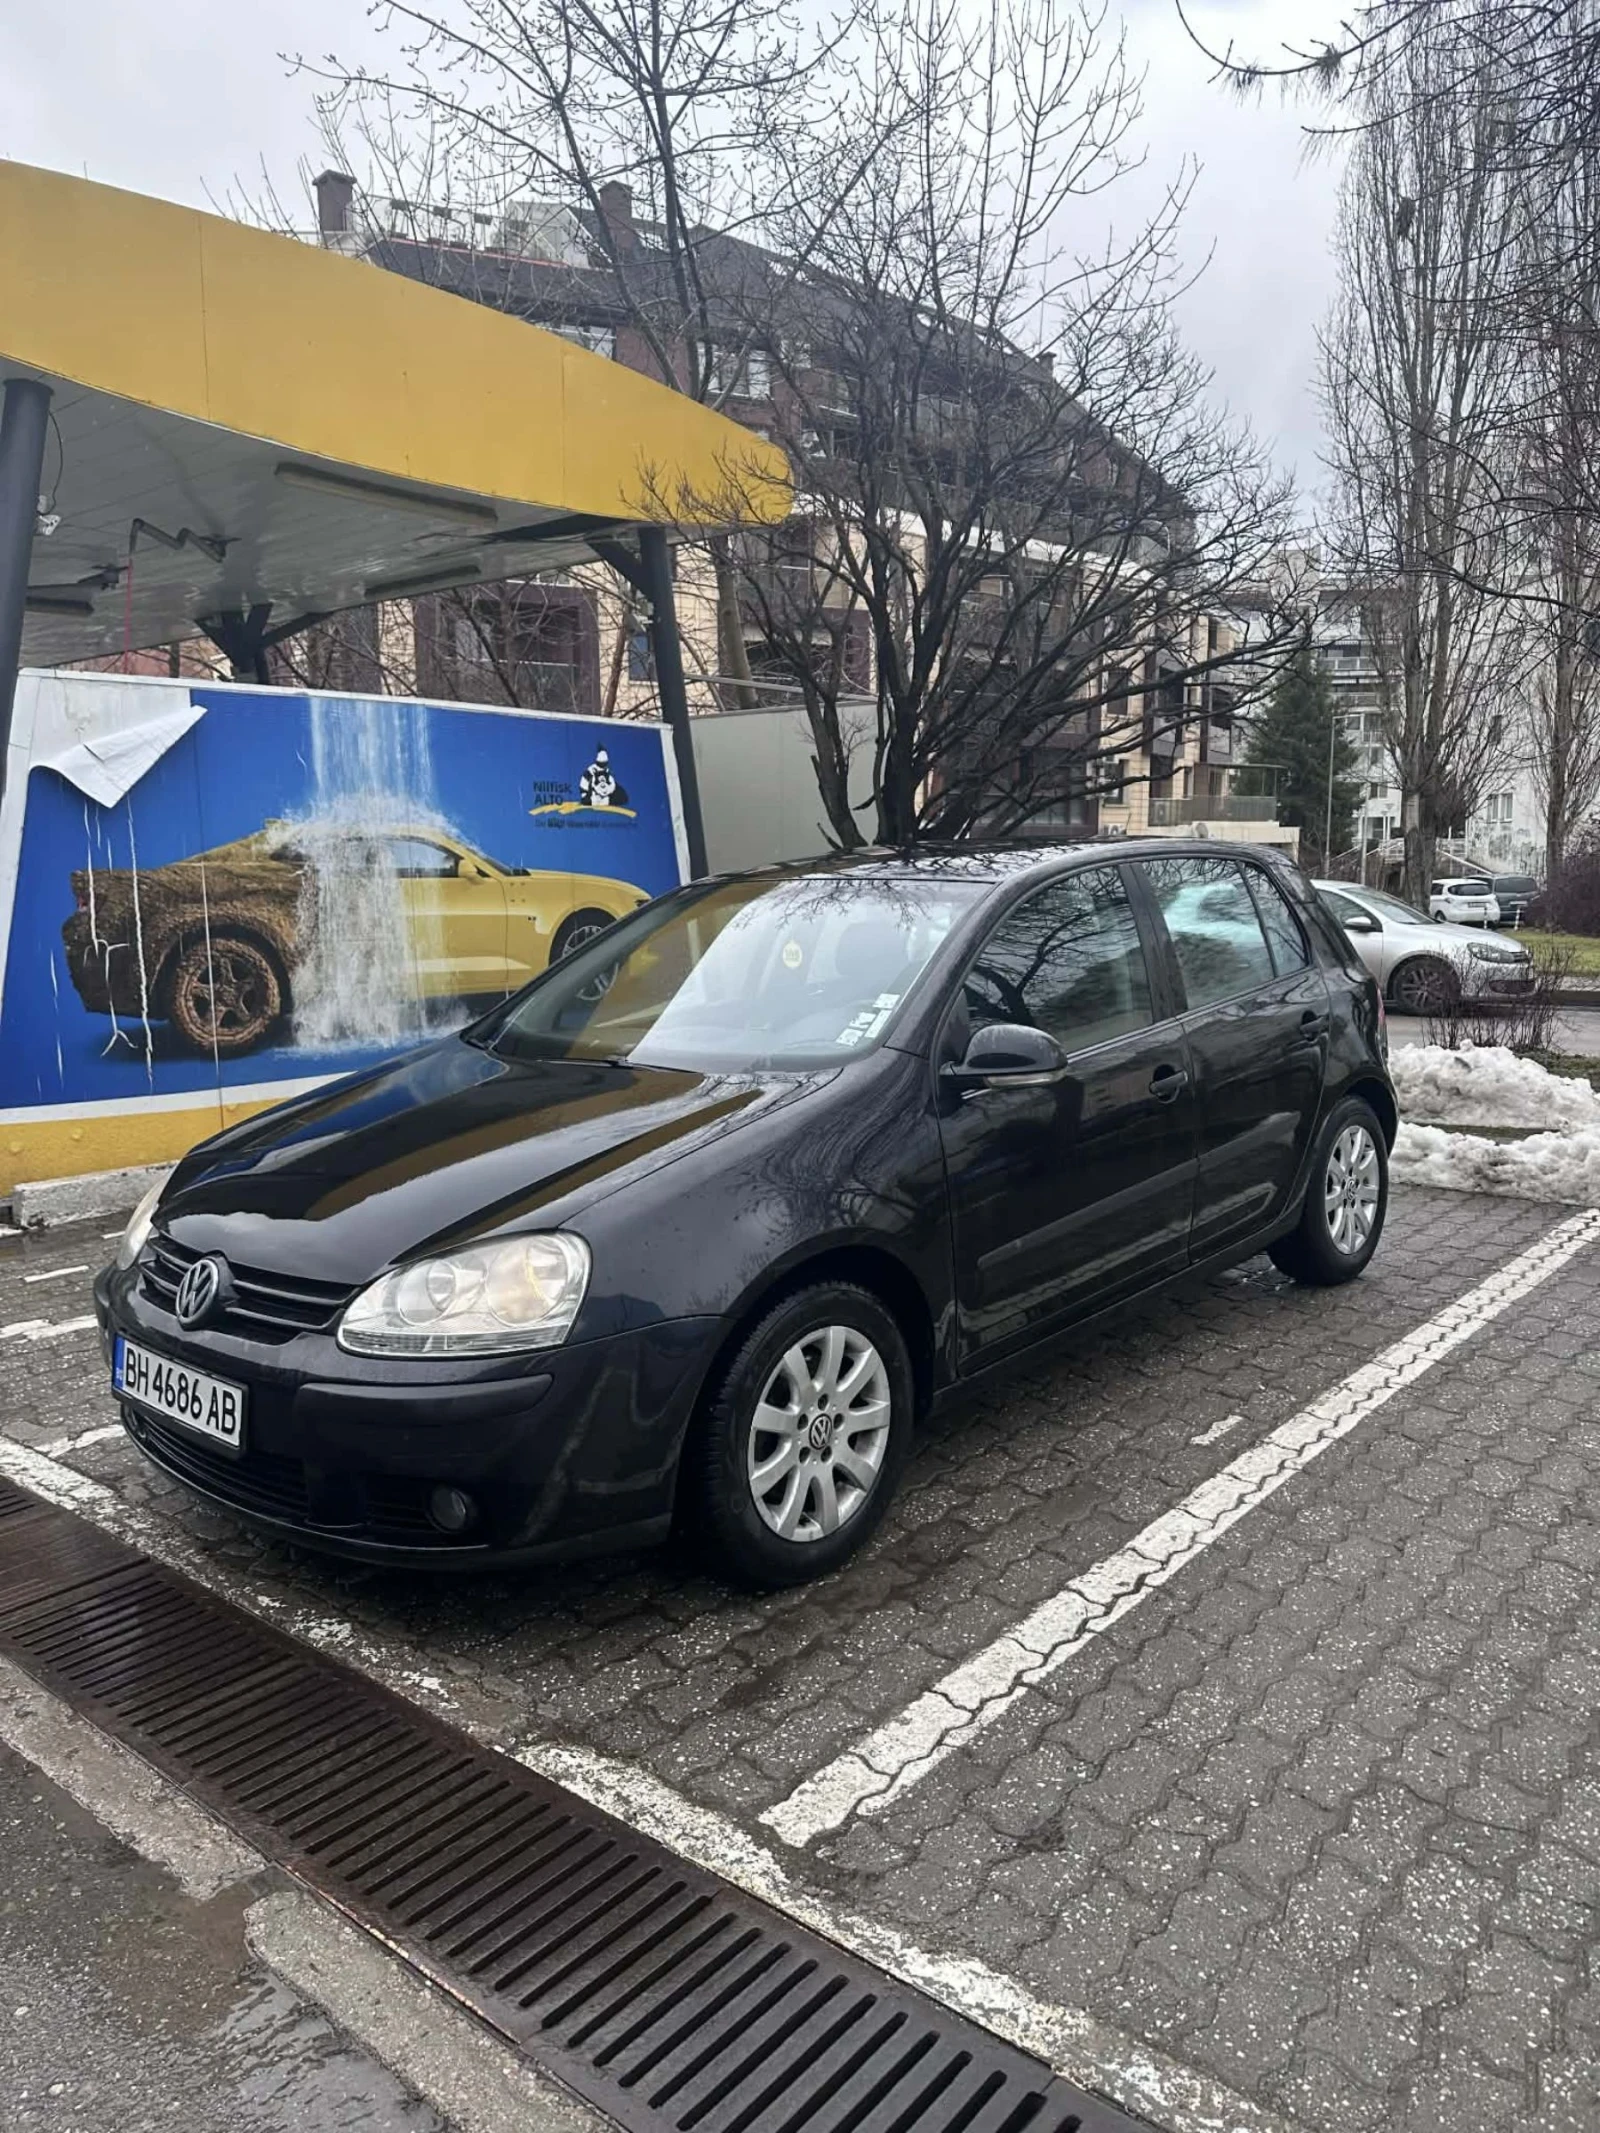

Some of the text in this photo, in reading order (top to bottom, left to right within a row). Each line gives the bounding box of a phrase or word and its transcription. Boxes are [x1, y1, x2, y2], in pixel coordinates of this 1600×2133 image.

[534, 781, 571, 794] Nilfisk
[535, 794, 563, 805] ALTO
[126, 1347, 237, 1435] BH 4686 AB
